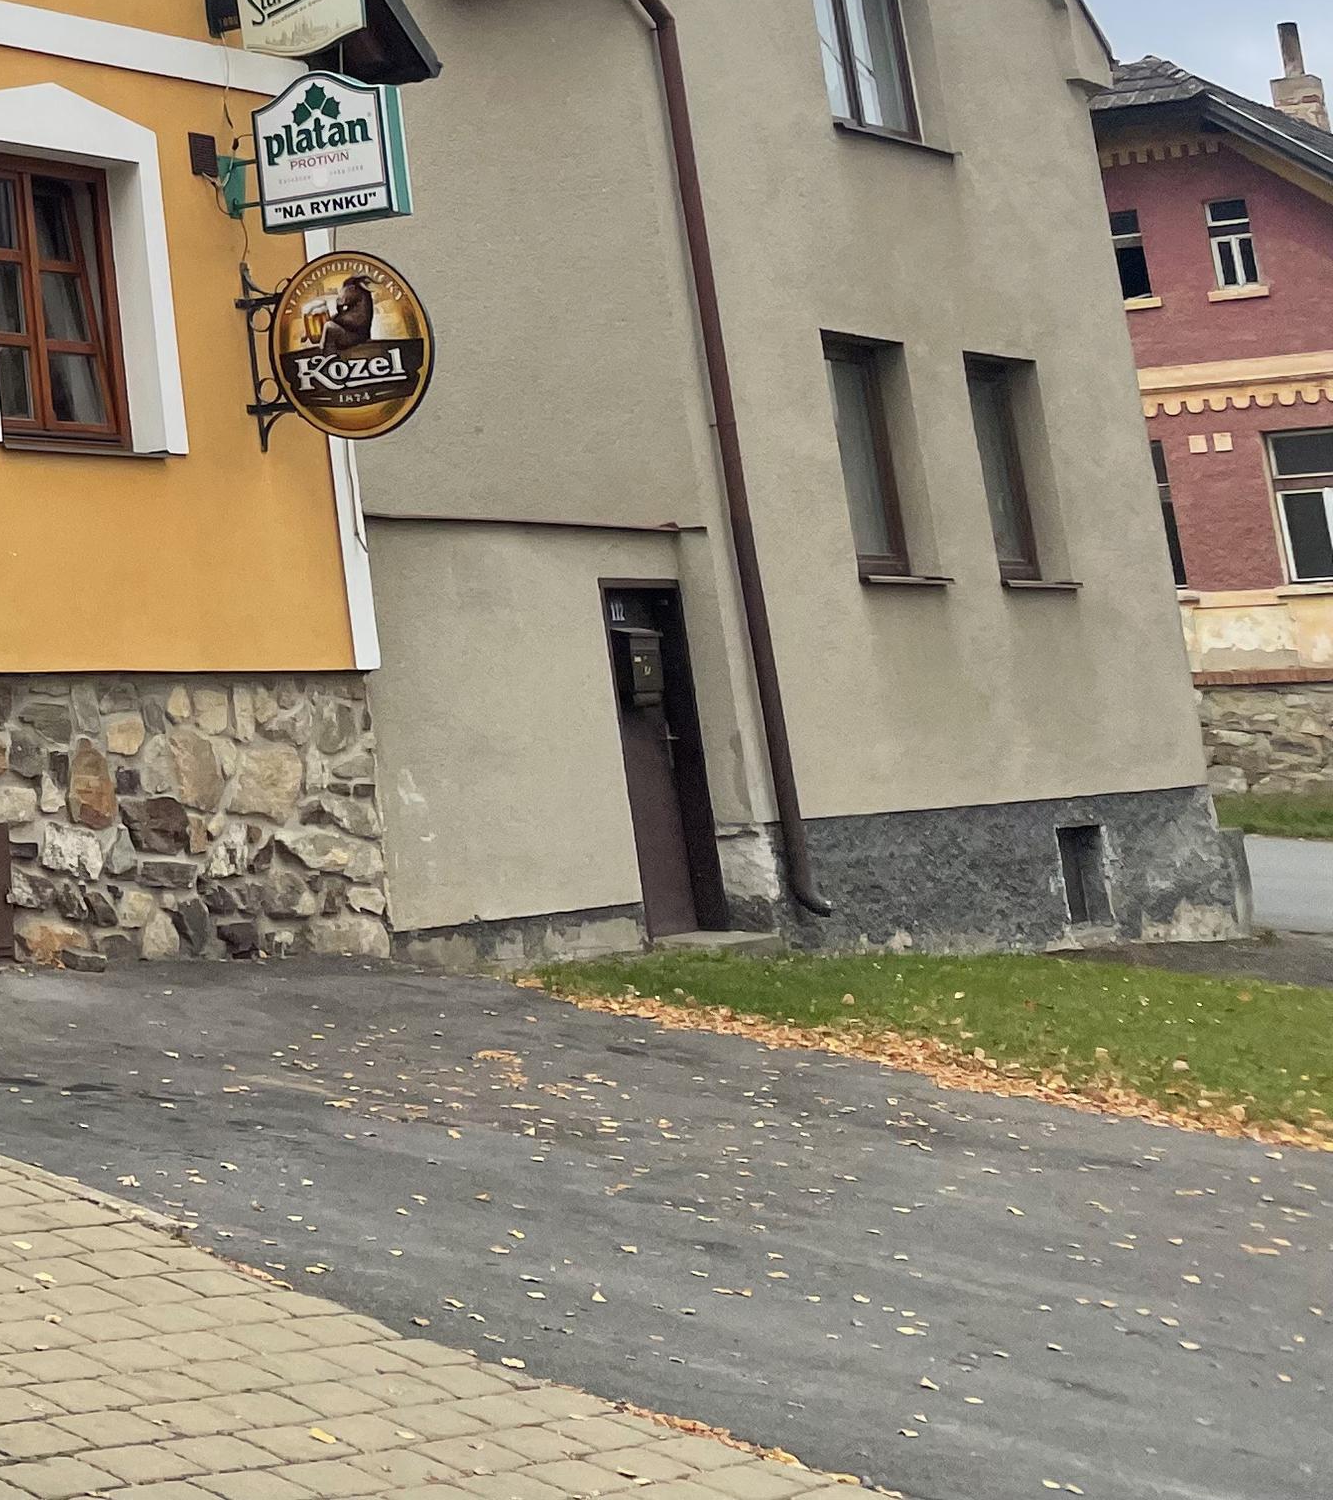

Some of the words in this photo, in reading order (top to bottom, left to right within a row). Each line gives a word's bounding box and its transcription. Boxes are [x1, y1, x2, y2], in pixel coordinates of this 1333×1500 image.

[263, 117, 372, 166] platan
[275, 203, 305, 219] "NA
[310, 192, 377, 215] RYNKU"
[295, 348, 406, 391] Kozel
